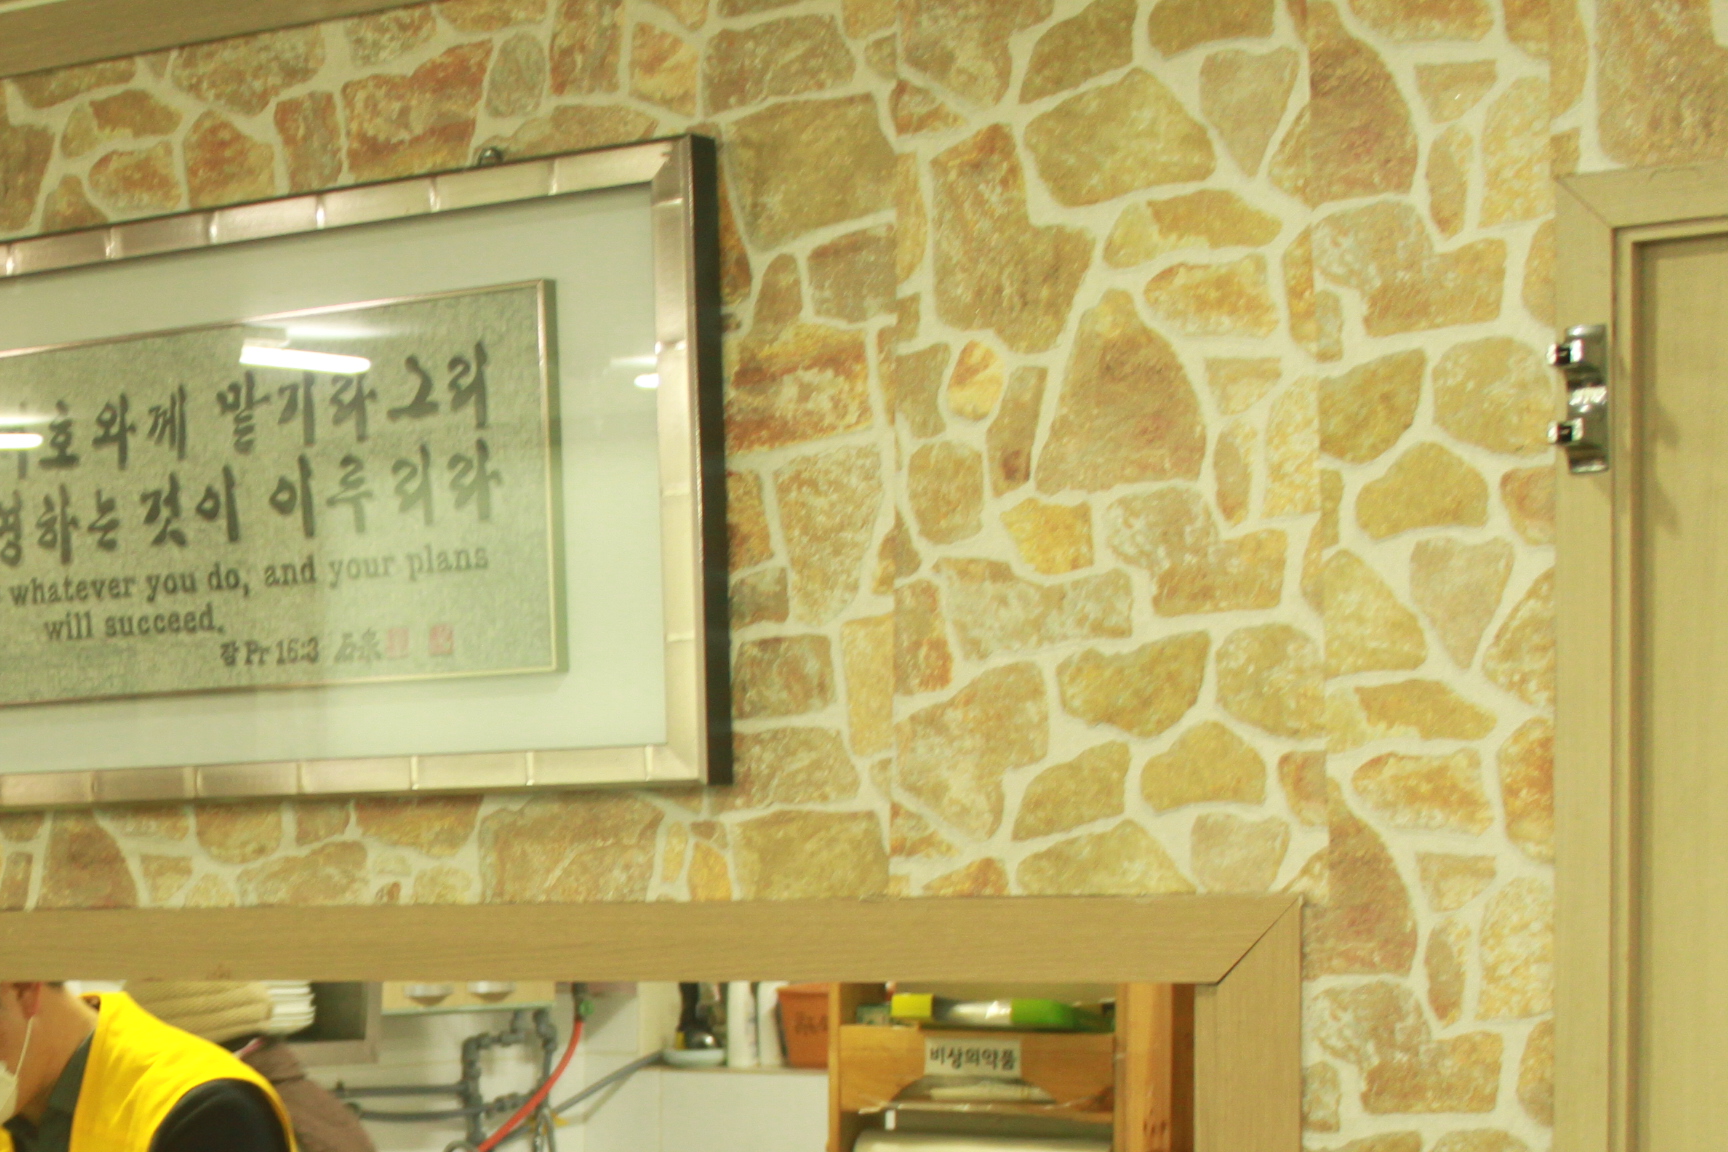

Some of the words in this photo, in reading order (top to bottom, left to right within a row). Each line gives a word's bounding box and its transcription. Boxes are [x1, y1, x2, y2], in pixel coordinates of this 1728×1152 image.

[215, 369, 377, 454] 맡기라
[386, 341, 489, 430] 그리
[140, 464, 241, 548] 것이
[269, 438, 504, 539] 이루리라
[9, 570, 136, 606] whatever
[146, 571, 197, 603] you
[208, 561, 250, 597] do,
[264, 556, 317, 588] and
[328, 553, 396, 589] your
[405, 543, 489, 582] plans
[43, 611, 94, 643] will
[103, 603, 226, 639] succeed.
[244, 639, 270, 666] Pr
[275, 636, 319, 666] 16:3
[929, 1045, 1015, 1071] 비상의약품
